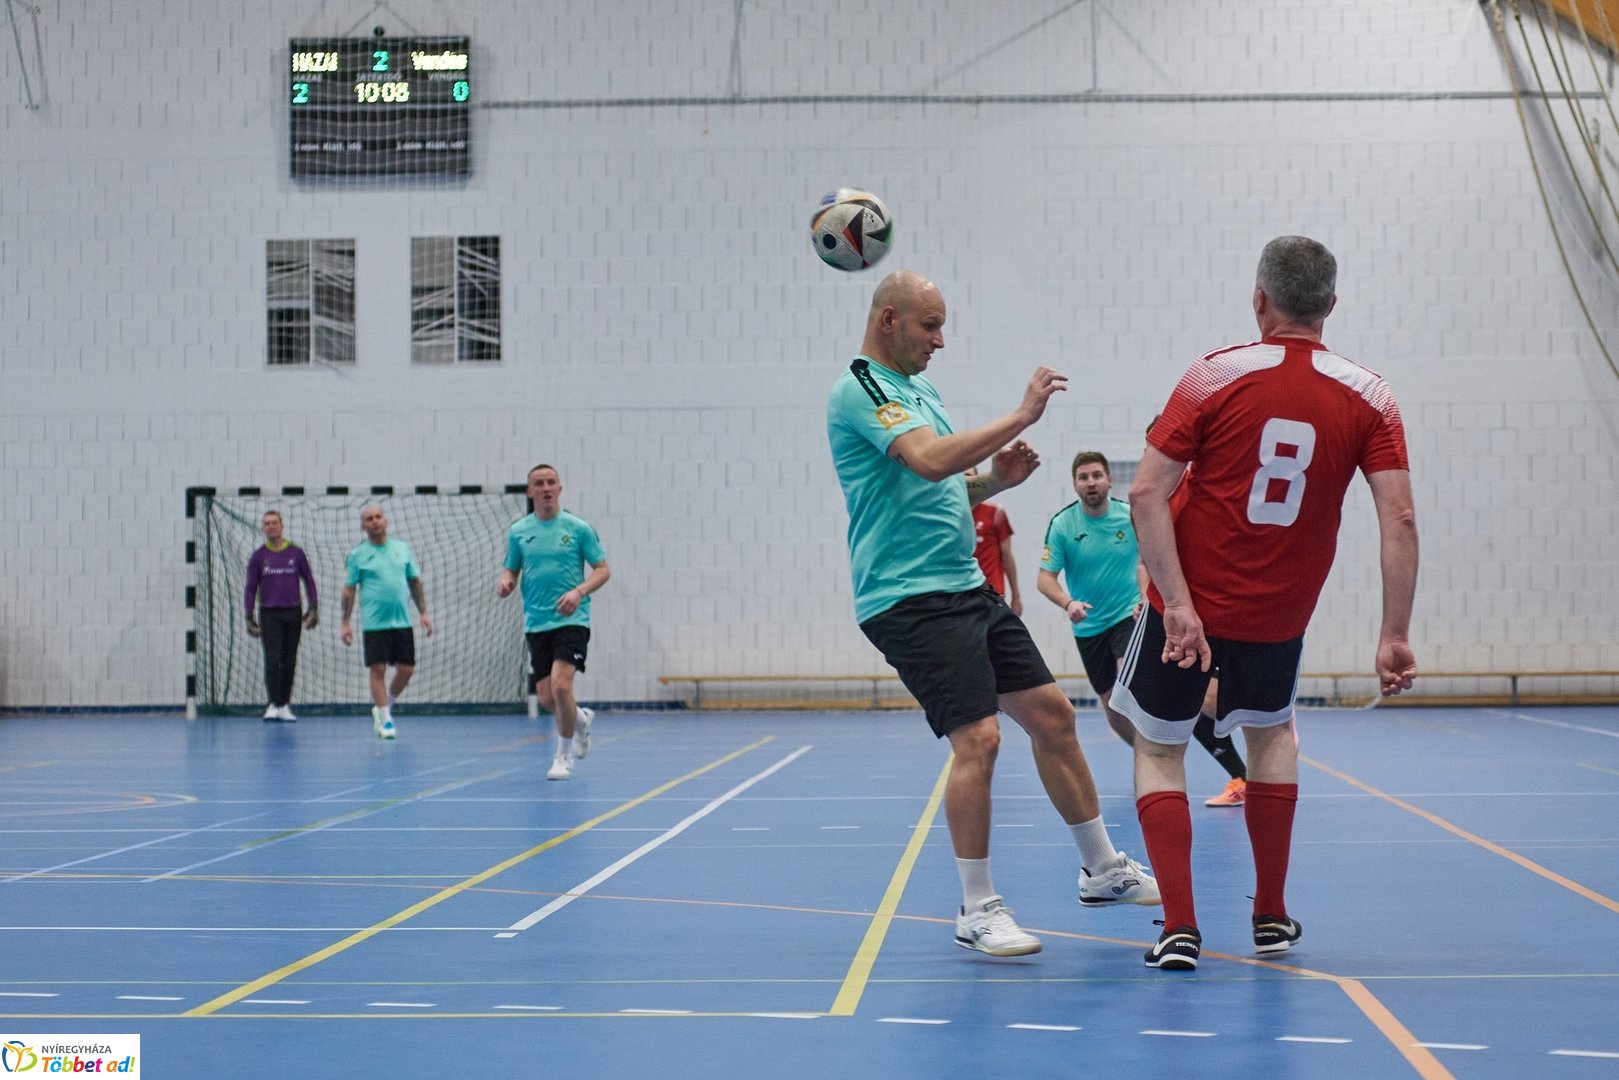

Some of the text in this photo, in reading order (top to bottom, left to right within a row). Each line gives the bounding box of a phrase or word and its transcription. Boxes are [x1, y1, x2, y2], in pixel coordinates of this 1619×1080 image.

[372, 51, 389, 71] 2
[292, 83, 309, 103] 2
[452, 81, 469, 102] 0
[1247, 418, 1316, 526] 8
